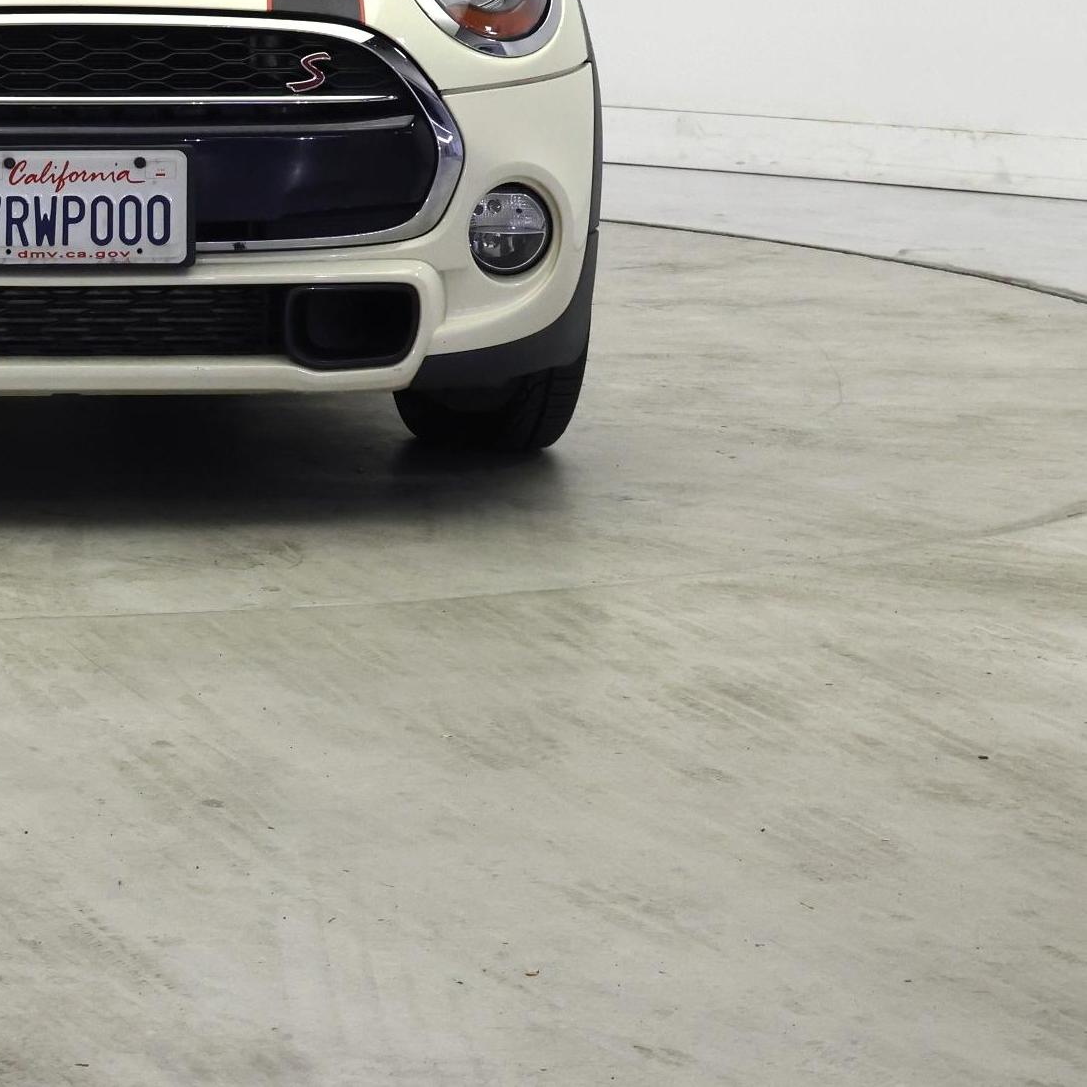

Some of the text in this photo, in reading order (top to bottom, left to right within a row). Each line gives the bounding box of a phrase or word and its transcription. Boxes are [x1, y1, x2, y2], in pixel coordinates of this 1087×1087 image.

[285, 51, 332, 93] S
[8, 160, 146, 193] California
[17, 249, 131, 259] dmv.ca.gov
